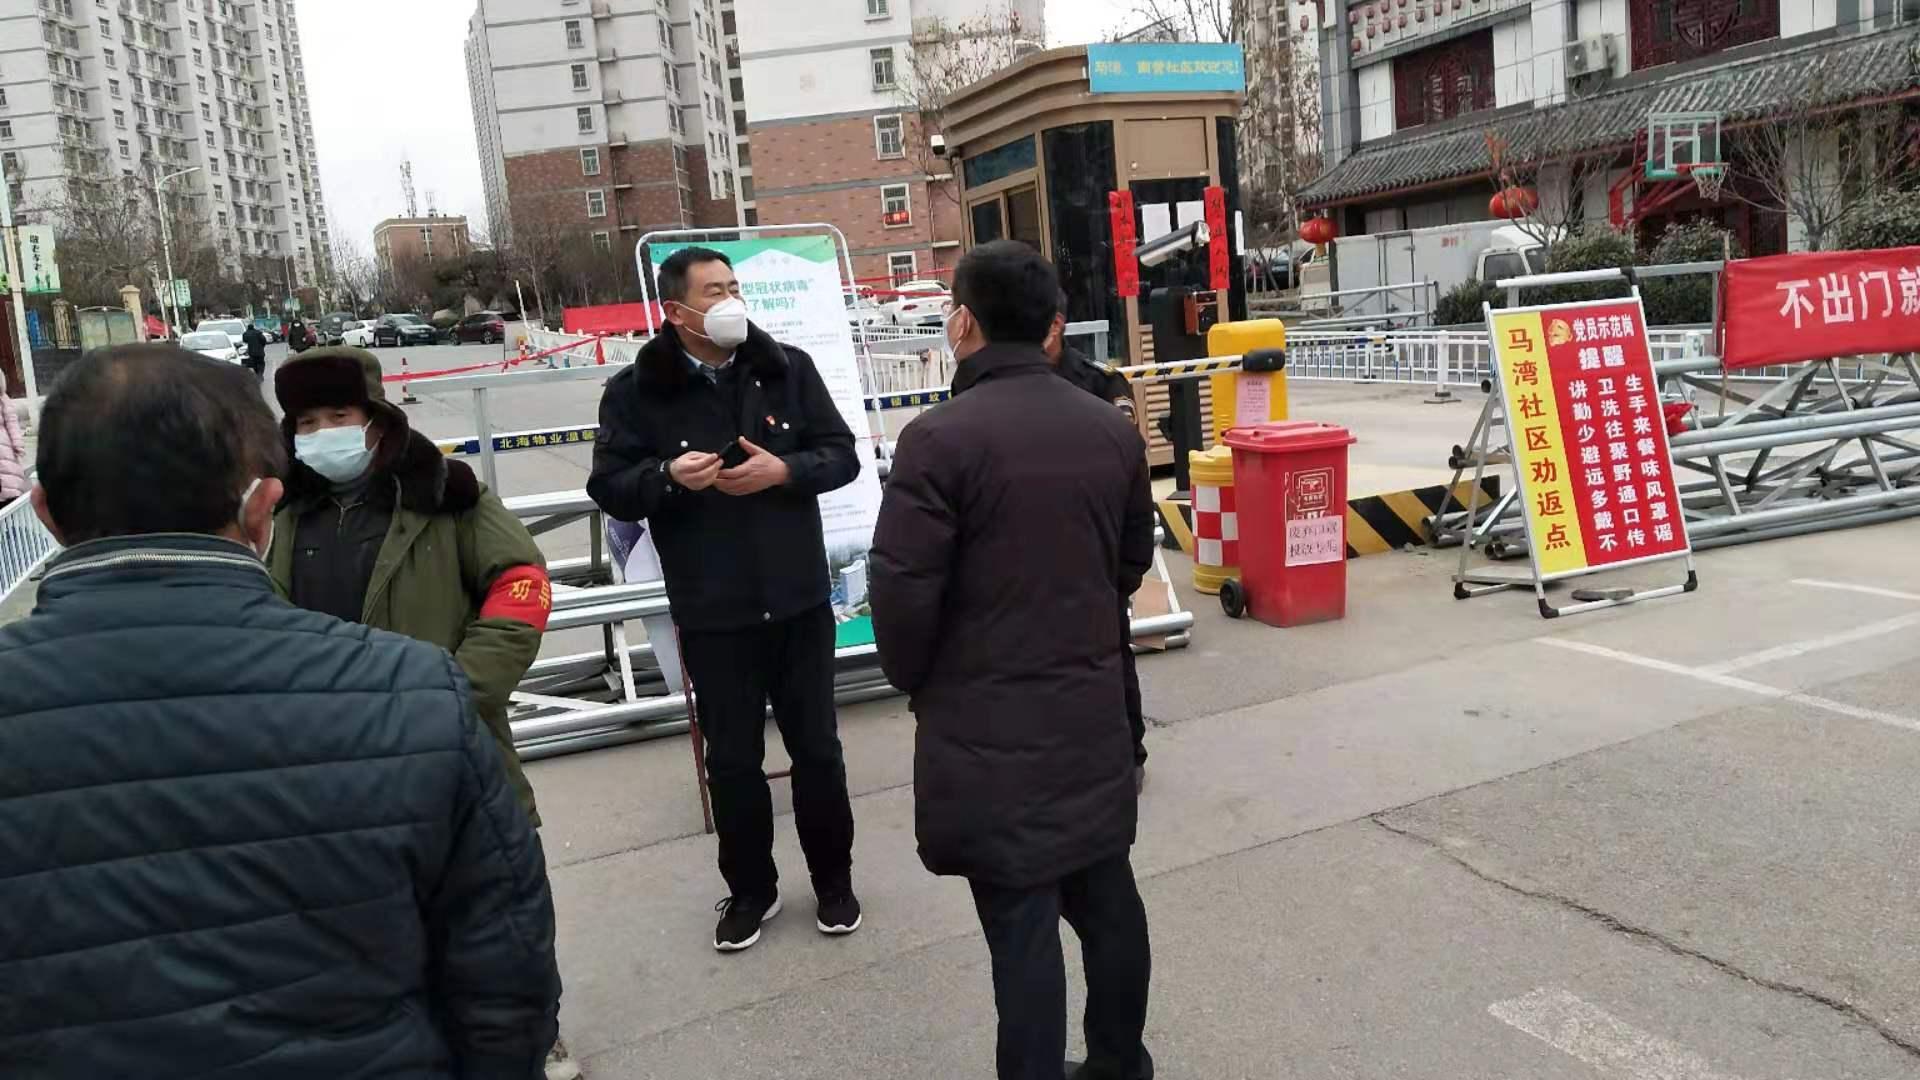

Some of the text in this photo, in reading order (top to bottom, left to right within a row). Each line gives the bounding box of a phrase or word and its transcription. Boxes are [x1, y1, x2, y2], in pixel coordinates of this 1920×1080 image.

[1775, 265, 1920, 329] 不出门就
[1572, 313, 1635, 343] 党员示范岗
[1578, 344, 1625, 371] 提醒
[1568, 373, 1645, 399] 讲卫生
[1572, 395, 1648, 421] 勤洗手
[1507, 328, 1572, 552] 马湾社区劝返点
[1577, 416, 1652, 444] 少往来
[1581, 437, 1656, 465] 避聚餐
[1585, 459, 1661, 487] 远野味
[1590, 481, 1666, 509] 多通风
[1593, 502, 1669, 531] 戴口罩
[1598, 524, 1674, 553] 不传谣
